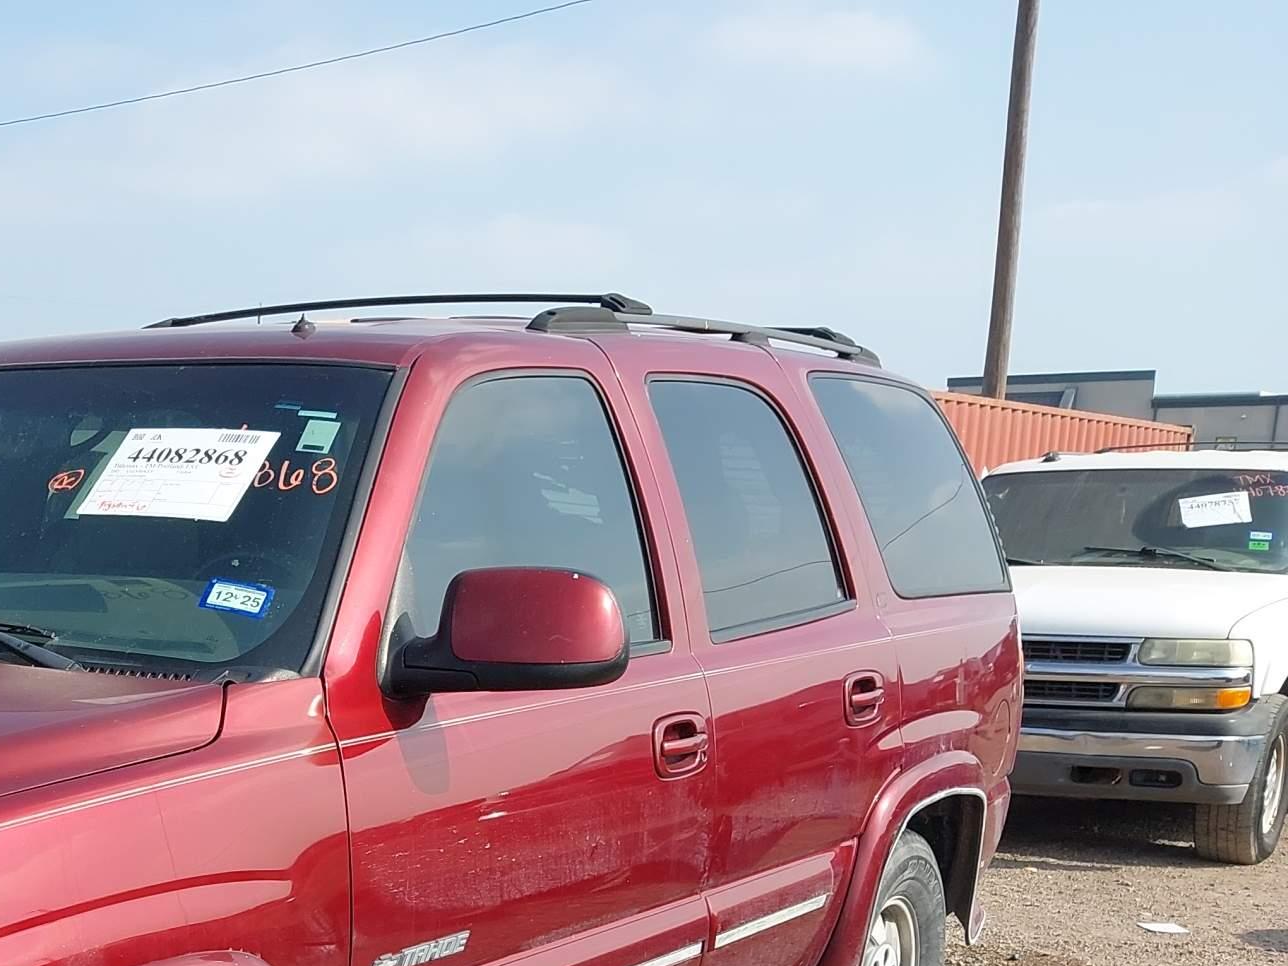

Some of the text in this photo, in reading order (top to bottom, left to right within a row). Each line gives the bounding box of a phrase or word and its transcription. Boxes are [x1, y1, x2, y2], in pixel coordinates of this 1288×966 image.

[128, 447, 248, 466] 44082868
[215, 590, 262, 608] 12 25
